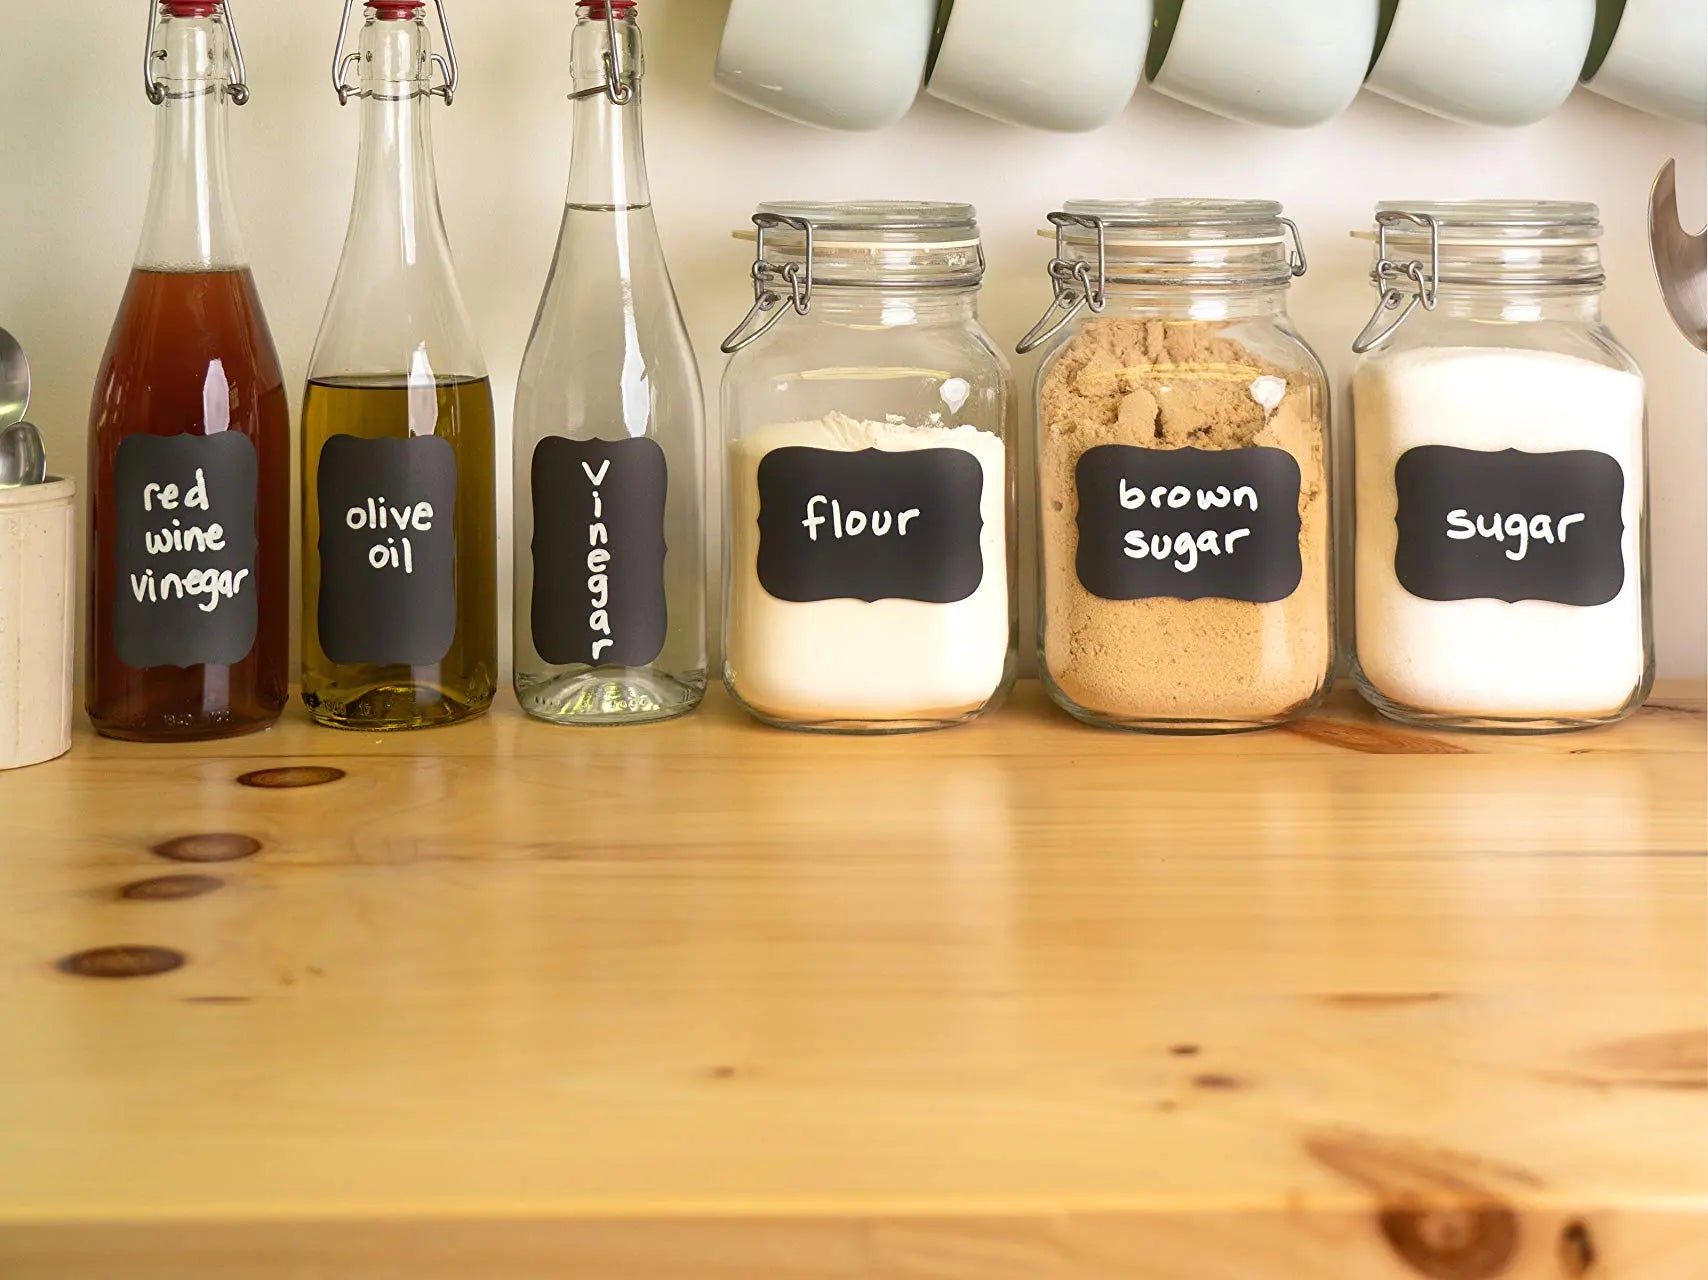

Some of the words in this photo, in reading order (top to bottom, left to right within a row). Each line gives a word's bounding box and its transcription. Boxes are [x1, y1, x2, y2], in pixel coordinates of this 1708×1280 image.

[144, 467, 210, 512] red
[1118, 477, 1259, 511] brown
[145, 518, 226, 555] wine
[345, 496, 434, 532] olive
[801, 493, 921, 542] flour
[1444, 503, 1586, 562] sugar
[368, 537, 413, 574] oil
[1122, 526, 1252, 574] sugar
[130, 567, 249, 613] vinegar
